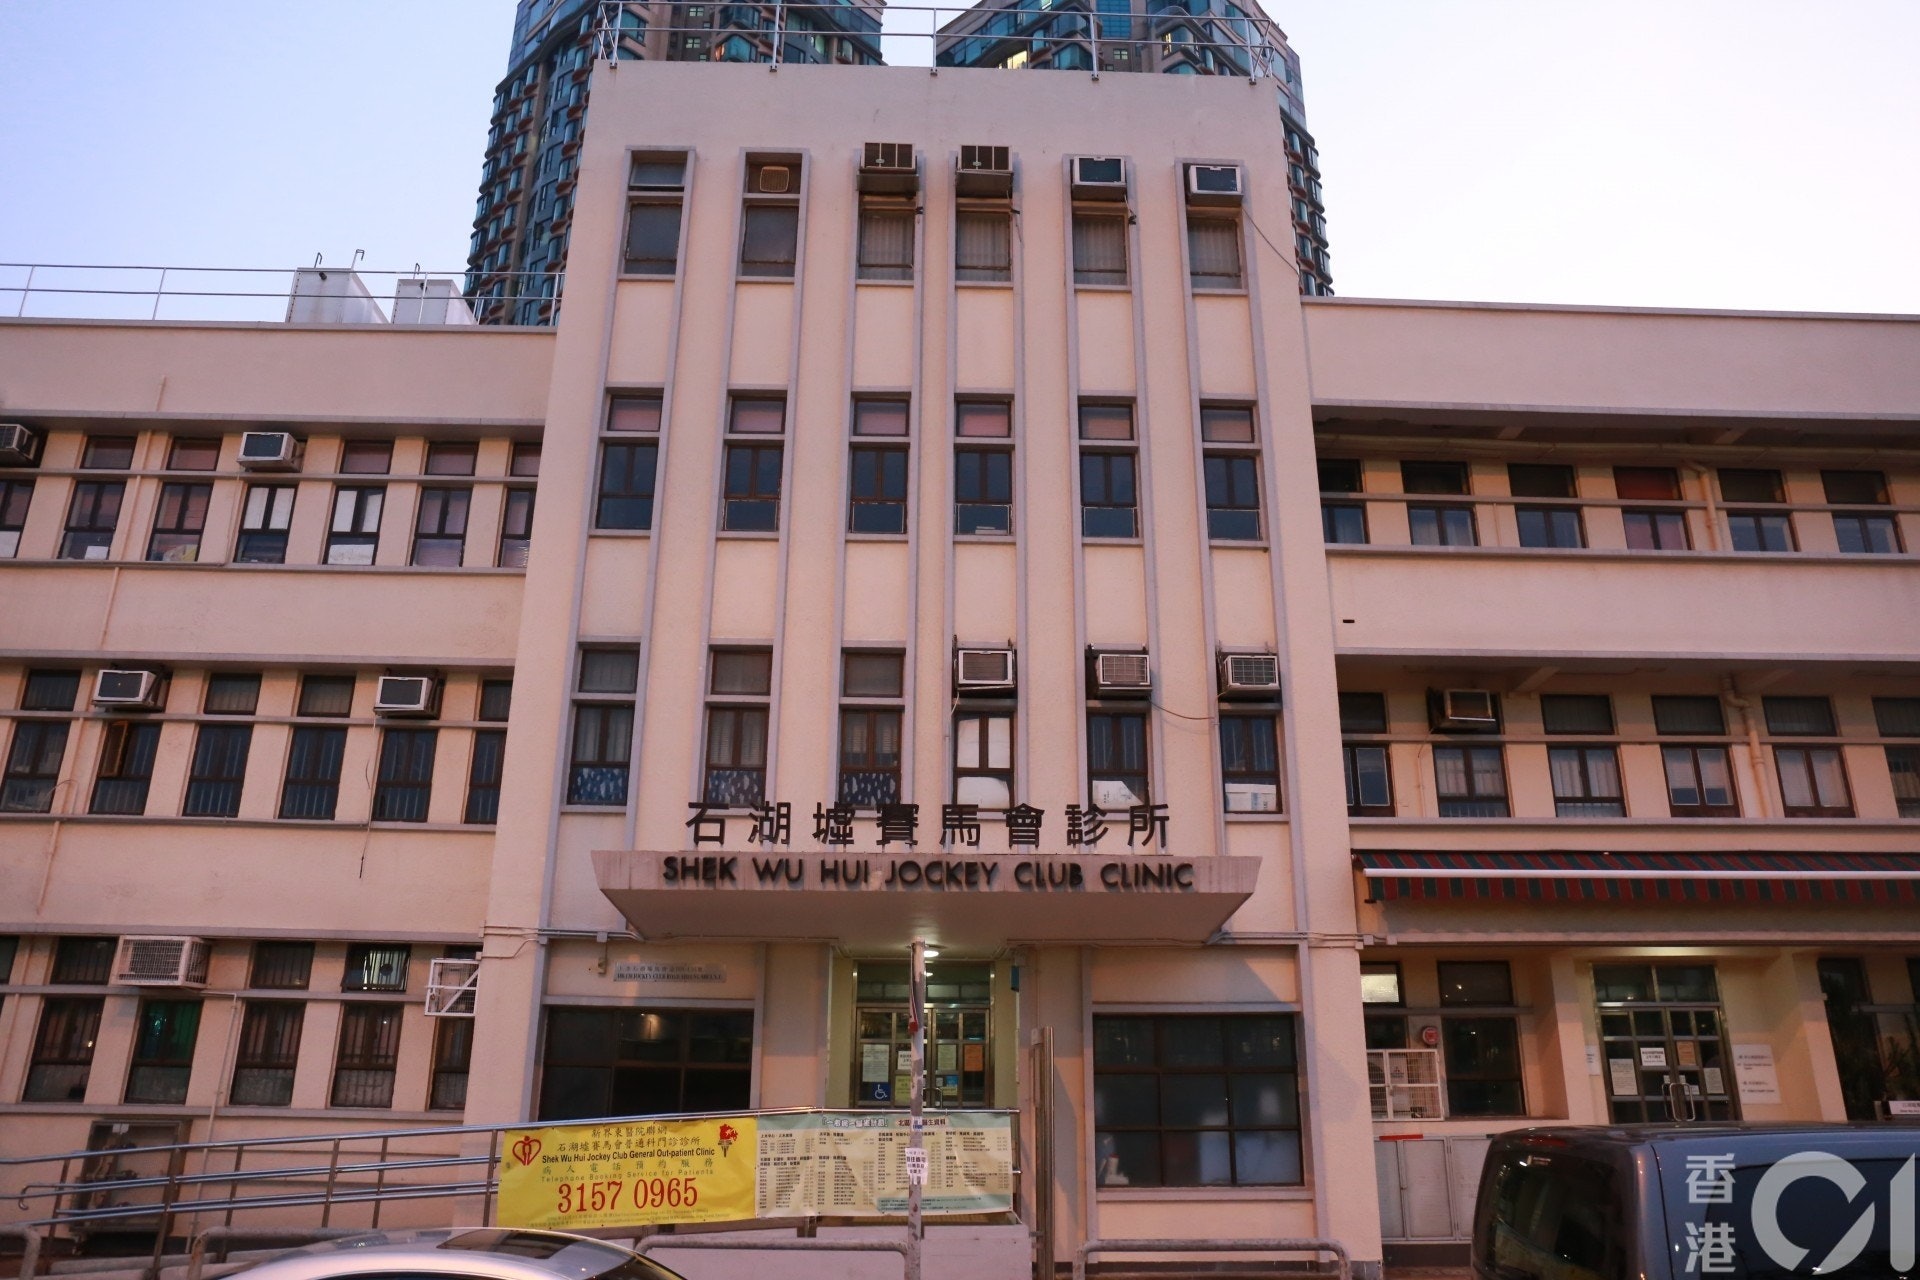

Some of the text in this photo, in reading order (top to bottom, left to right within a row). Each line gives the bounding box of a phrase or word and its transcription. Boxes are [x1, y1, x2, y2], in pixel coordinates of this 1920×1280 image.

[685, 801, 1170, 848] 石湖墟賽馬會診所
[663, 856, 1193, 888] SHEK WU HUI JOCKEY CLUB CLINIC
[591, 1125, 668, 1139] 新界東醫院聯網
[542, 1147, 715, 1164] Shek Wu Hui Jockey Club General Out-patient Clinic
[541, 1175, 585, 1183] Telephone
[590, 1173, 622, 1181] Booking
[627, 1170, 658, 1178] Service
[558, 1177, 698, 1214] 3157 0965
